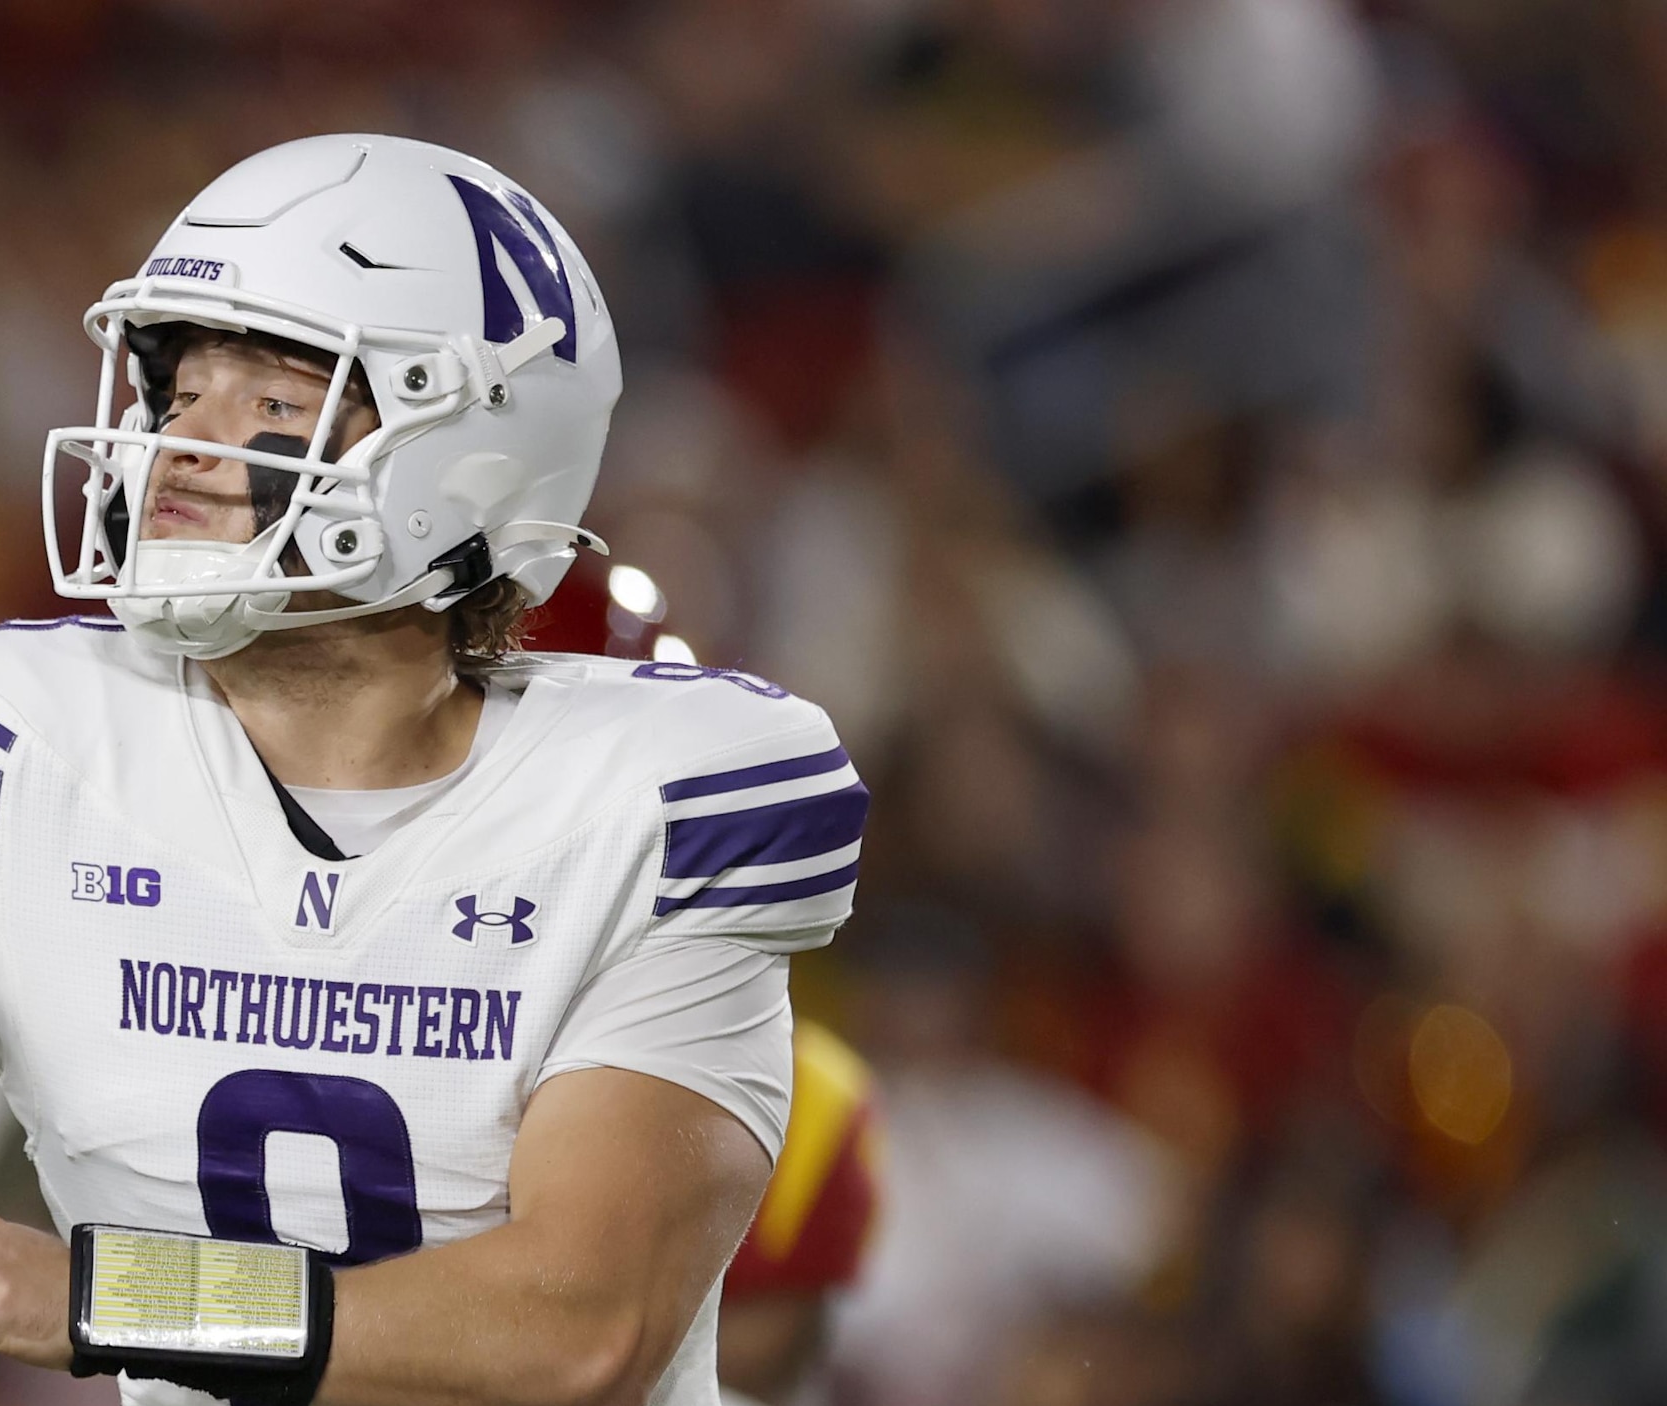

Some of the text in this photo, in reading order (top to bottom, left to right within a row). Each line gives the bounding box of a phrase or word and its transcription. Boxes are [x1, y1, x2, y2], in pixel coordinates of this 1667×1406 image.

[146, 257, 226, 281] WILDCATS
[444, 173, 577, 365] N
[295, 870, 340, 930] N
[118, 957, 523, 1062] NORTHWESTERN
